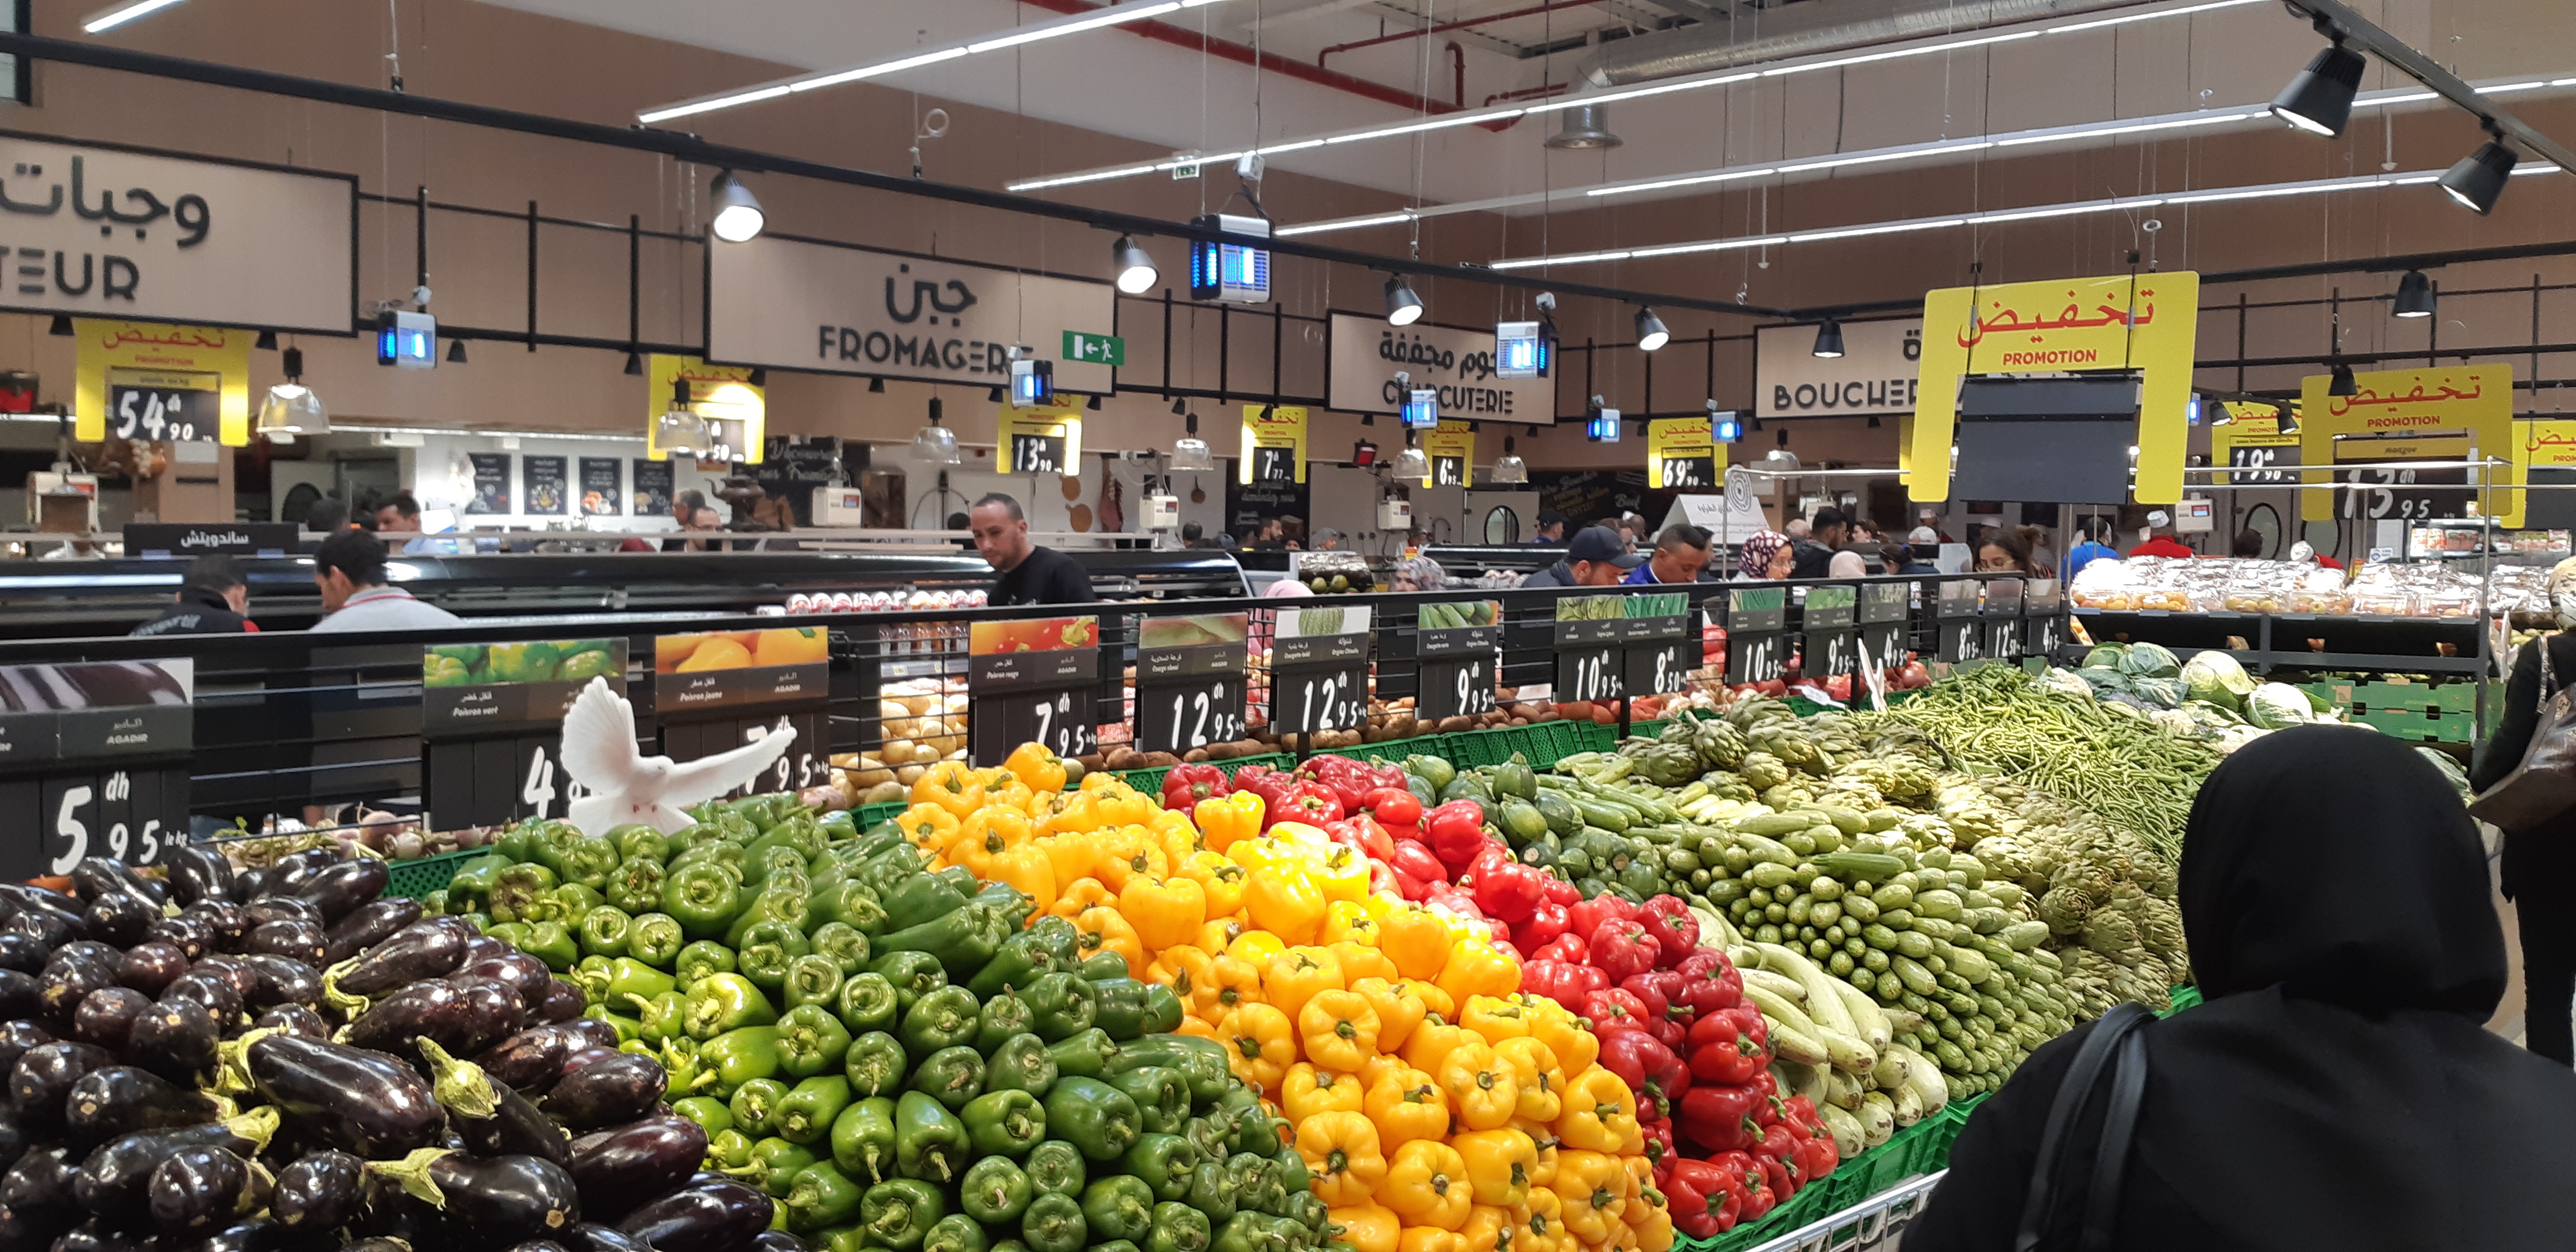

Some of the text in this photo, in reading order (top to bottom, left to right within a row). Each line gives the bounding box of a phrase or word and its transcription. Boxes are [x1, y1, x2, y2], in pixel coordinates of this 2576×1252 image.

[886, 263, 978, 327] جبن
[1957, 290, 2154, 348] تخفيض
[820, 325, 1034, 375] FROMAGER
[2003, 349, 2097, 366] PROMOTION
[1383, 380, 1513, 414] CCUTERIE
[2330, 375, 2481, 416] تخفيض
[116, 390, 166, 440] 54
[169, 423, 194, 442] 90
[2367, 416, 2441, 428] PROMOTION
[1017, 438, 1039, 472] 13
[1040, 459, 1052, 472] 90
[1265, 450, 1273, 480] 7
[1440, 458, 1447, 485] 6
[1663, 459, 1687, 487] 69
[2400, 499, 2431, 519] 95
[181, 529, 249, 548] ساندويتش
[1829, 638, 1837, 675] 9
[1884, 633, 1892, 668] 4
[1958, 627, 1966, 661] 8
[1995, 625, 2009, 658] 12
[1576, 656, 1599, 701] 10
[1601, 675, 1617, 698] 95
[1655, 652, 1666, 694] 8
[1745, 643, 1764, 683] 10
[1059, 692, 1070, 713] dh
[1303, 678, 1335, 732] 12
[1339, 700, 1357, 727] 95
[1458, 668, 1469, 715] 9
[1472, 687, 1489, 714] 95
[106, 733, 149, 744] AGADIR
[1036, 701, 1052, 744] 7
[1172, 691, 1209, 750] 12
[1215, 713, 1235, 741] 95
[1060, 724, 1085, 757] 95
[105, 771, 130, 802] dh
[524, 745, 556, 820] 4
[778, 753, 811, 791] 95
[53, 785, 92, 875] 5
[110, 819, 160, 864] 95
